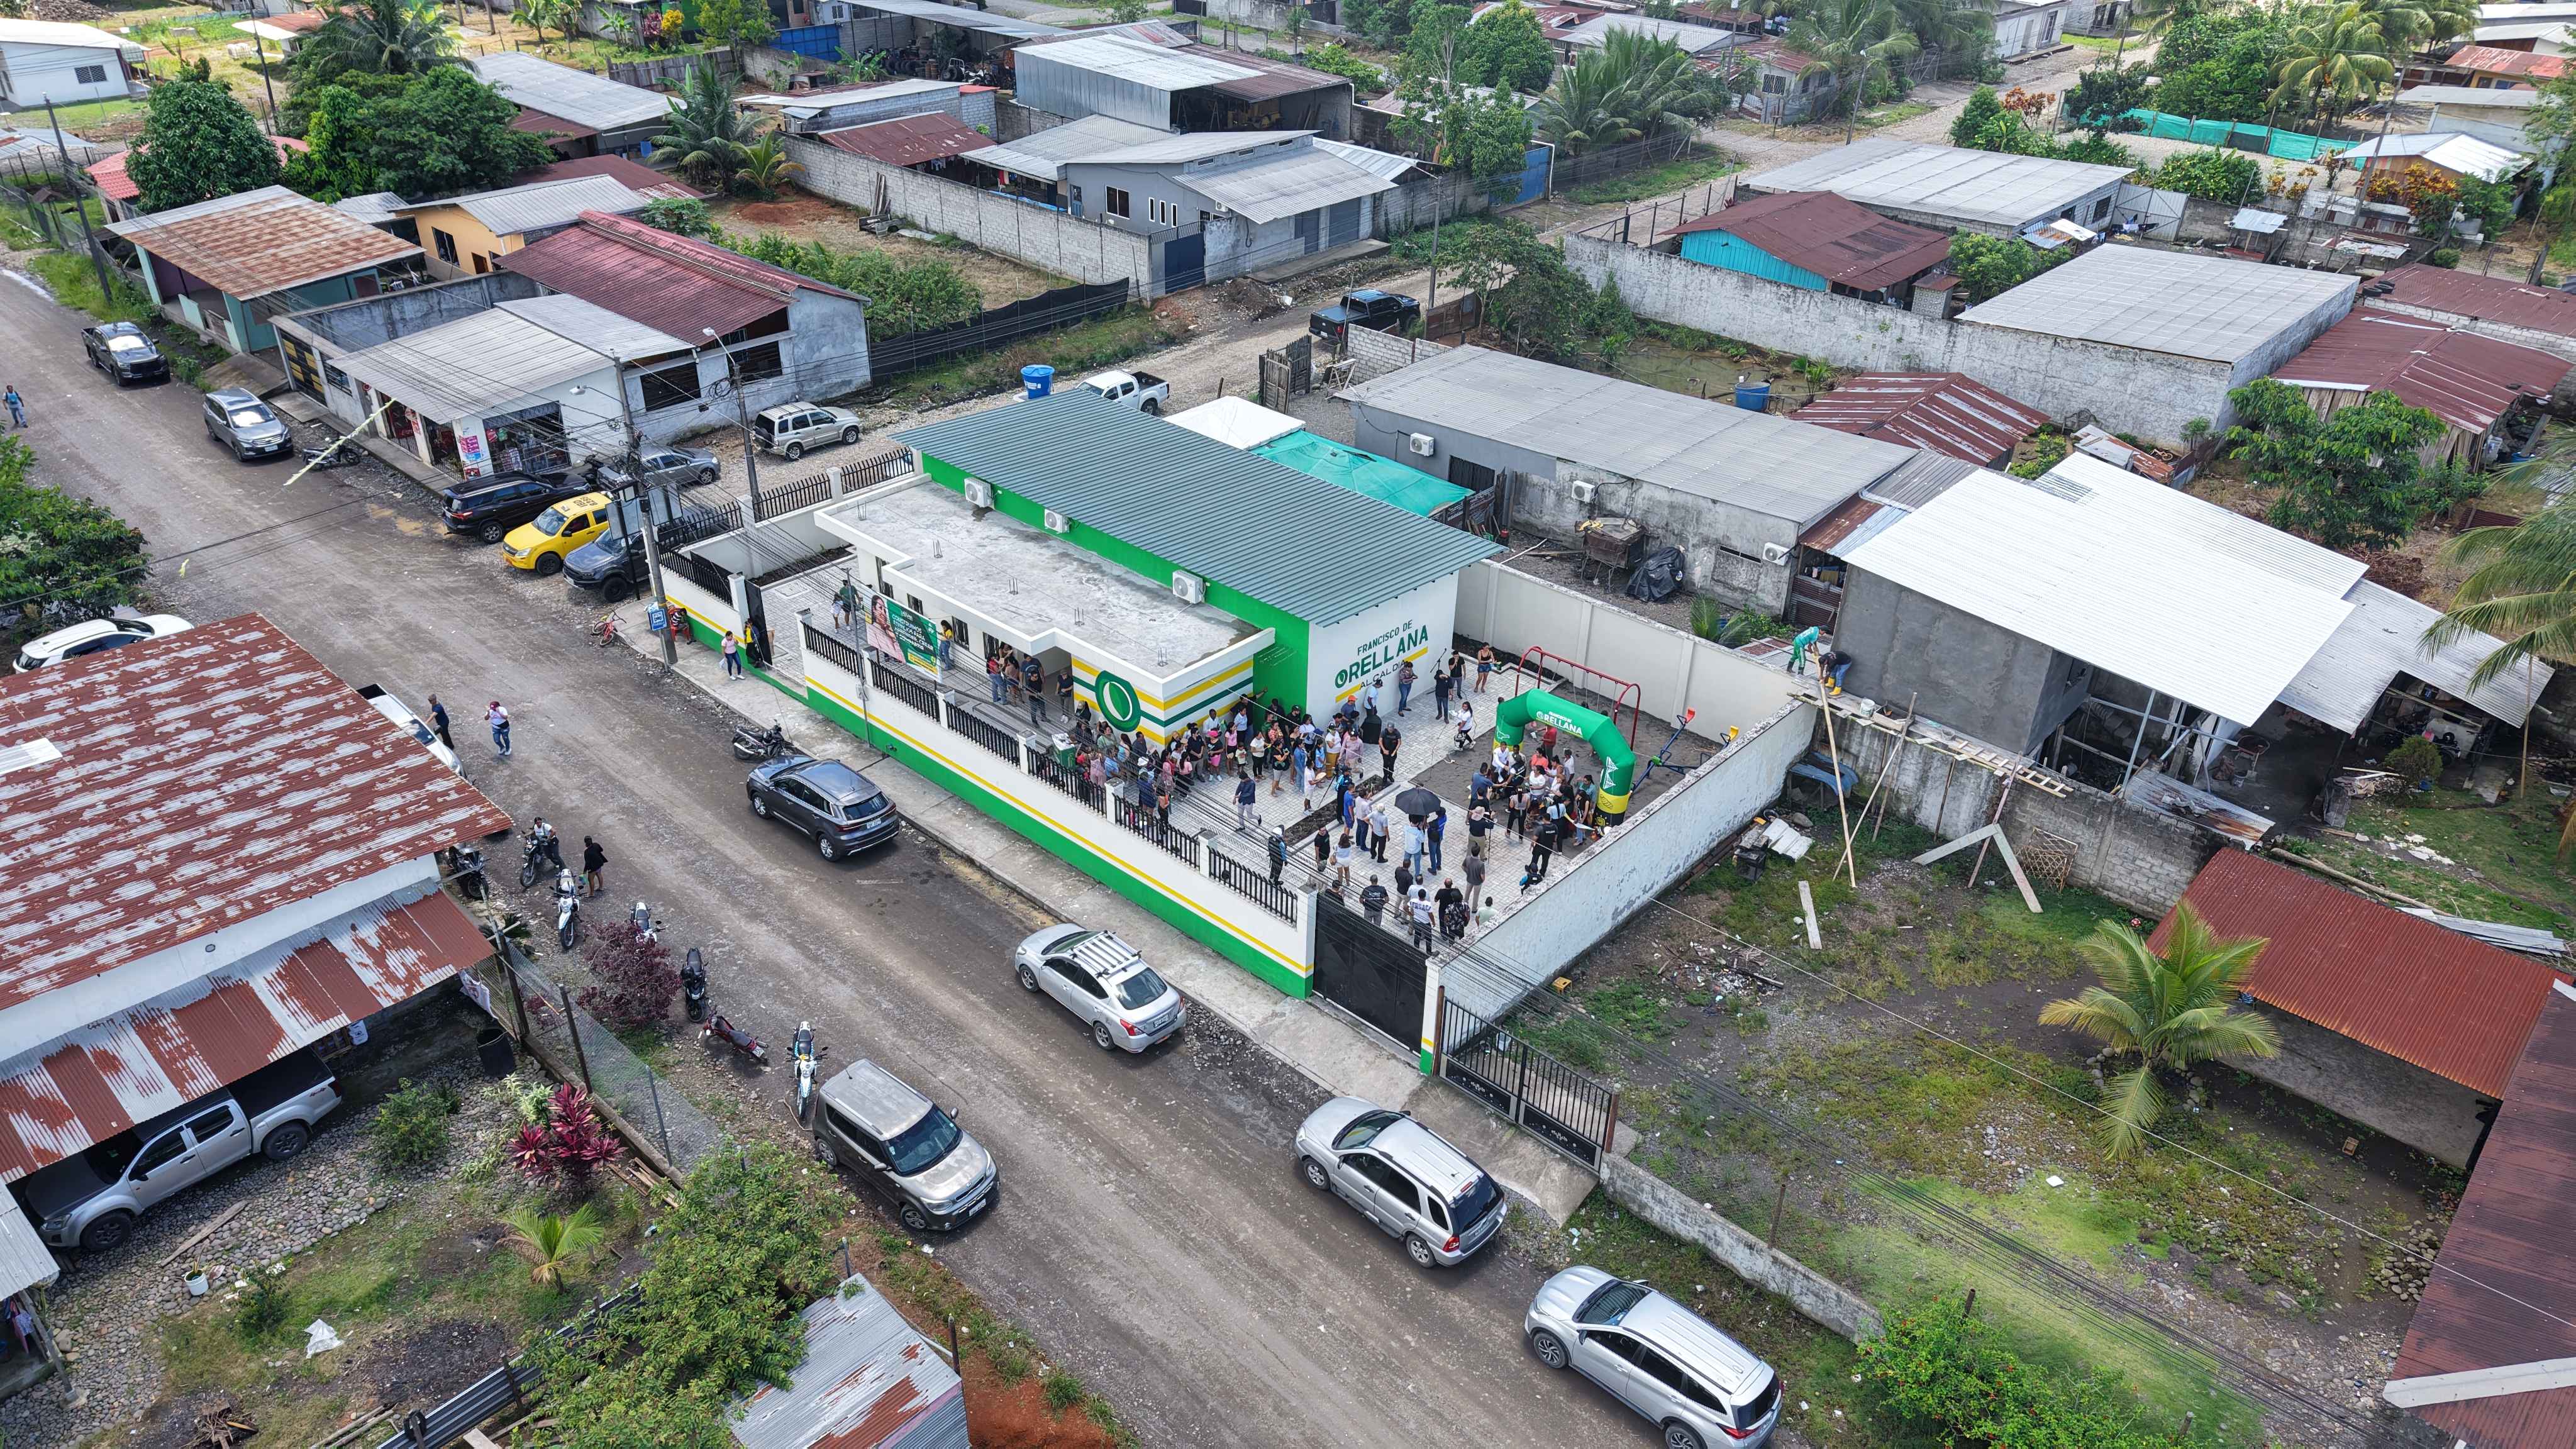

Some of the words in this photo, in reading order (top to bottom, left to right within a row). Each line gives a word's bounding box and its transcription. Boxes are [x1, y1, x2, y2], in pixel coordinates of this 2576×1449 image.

[1357, 626, 1400, 656] FRANCISCO
[1402, 619, 1413, 632] DE
[1335, 625, 1428, 689] ORELLANA
[1548, 711, 1567, 721] FRANCISCO
